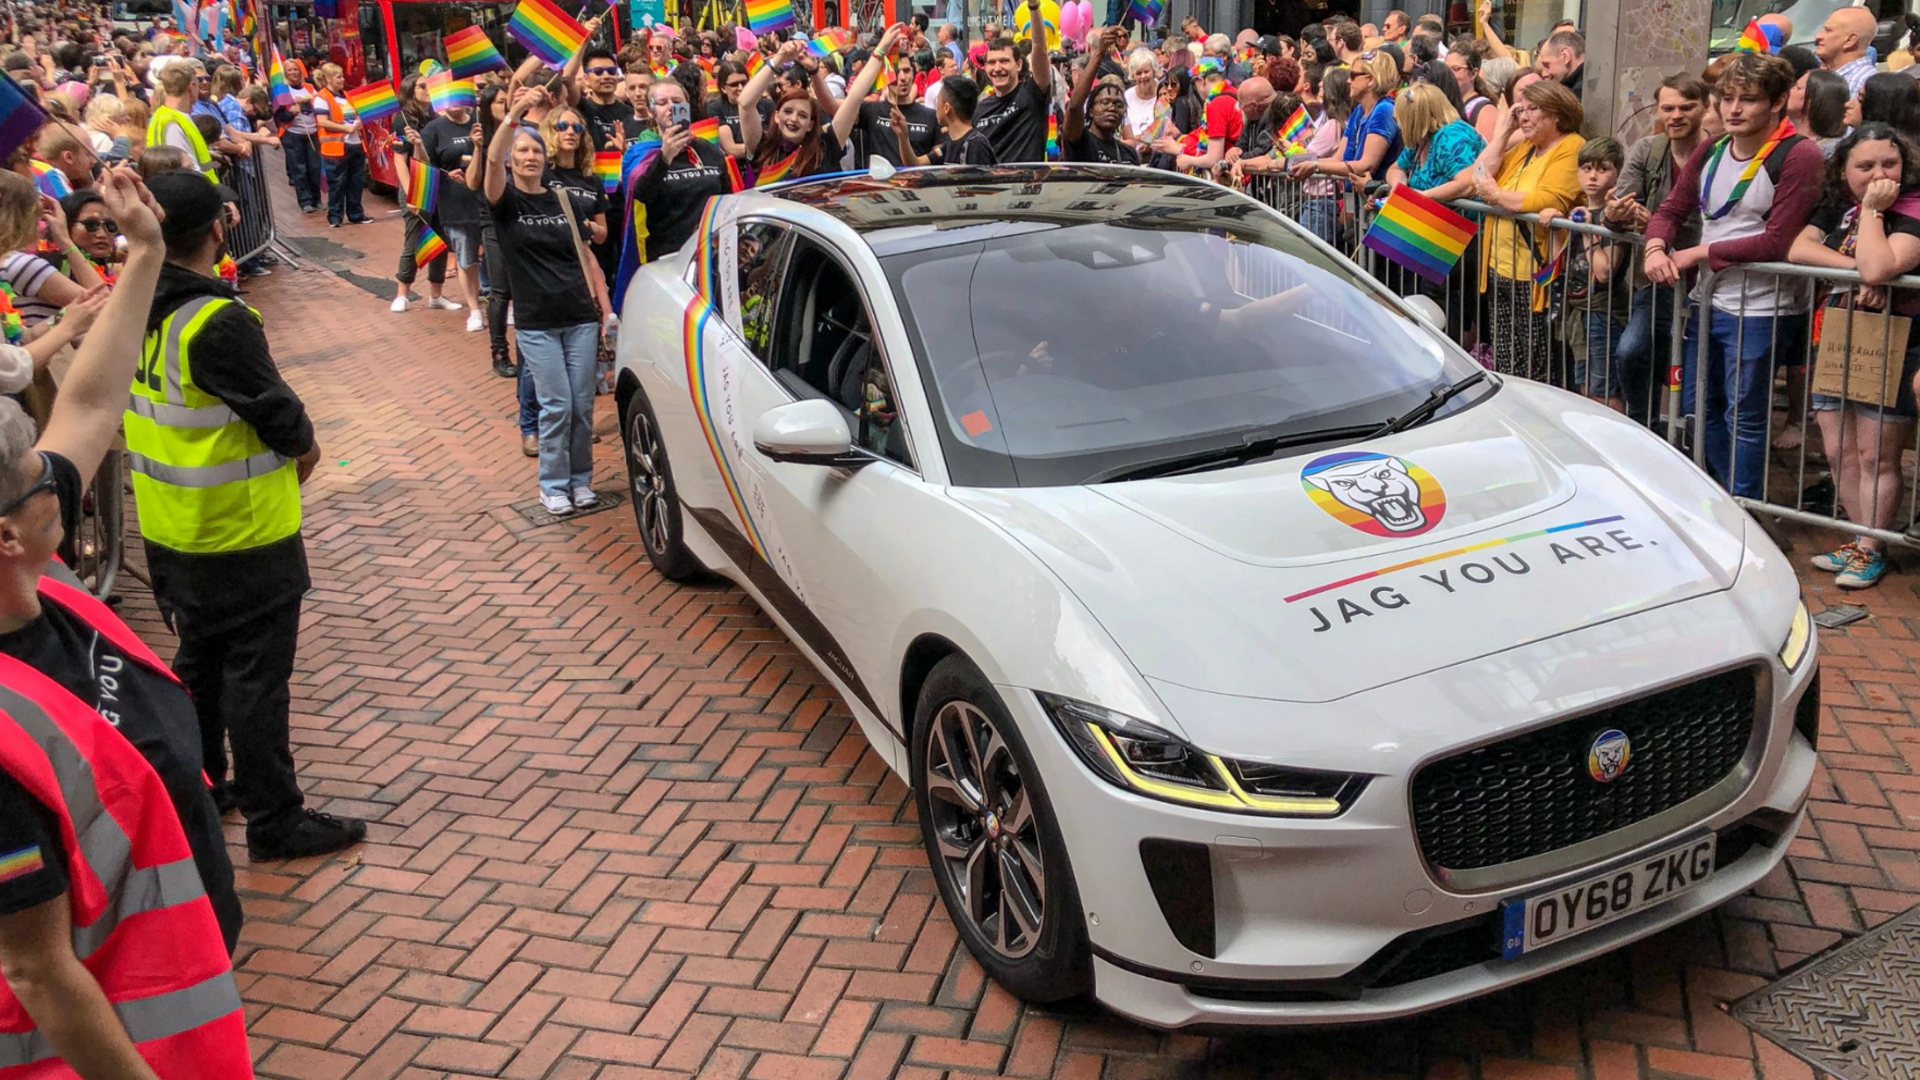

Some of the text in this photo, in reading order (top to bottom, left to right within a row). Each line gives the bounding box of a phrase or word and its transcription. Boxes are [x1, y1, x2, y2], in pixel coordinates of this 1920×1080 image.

[682, 170, 701, 179] YOU
[725, 396, 734, 425] YOU
[1309, 529, 1659, 633] JAG YOU ARE.
[100, 654, 123, 701] YOU
[827, 650, 855, 680] JAGUAR
[1534, 841, 1711, 939] OY68 ZKG
